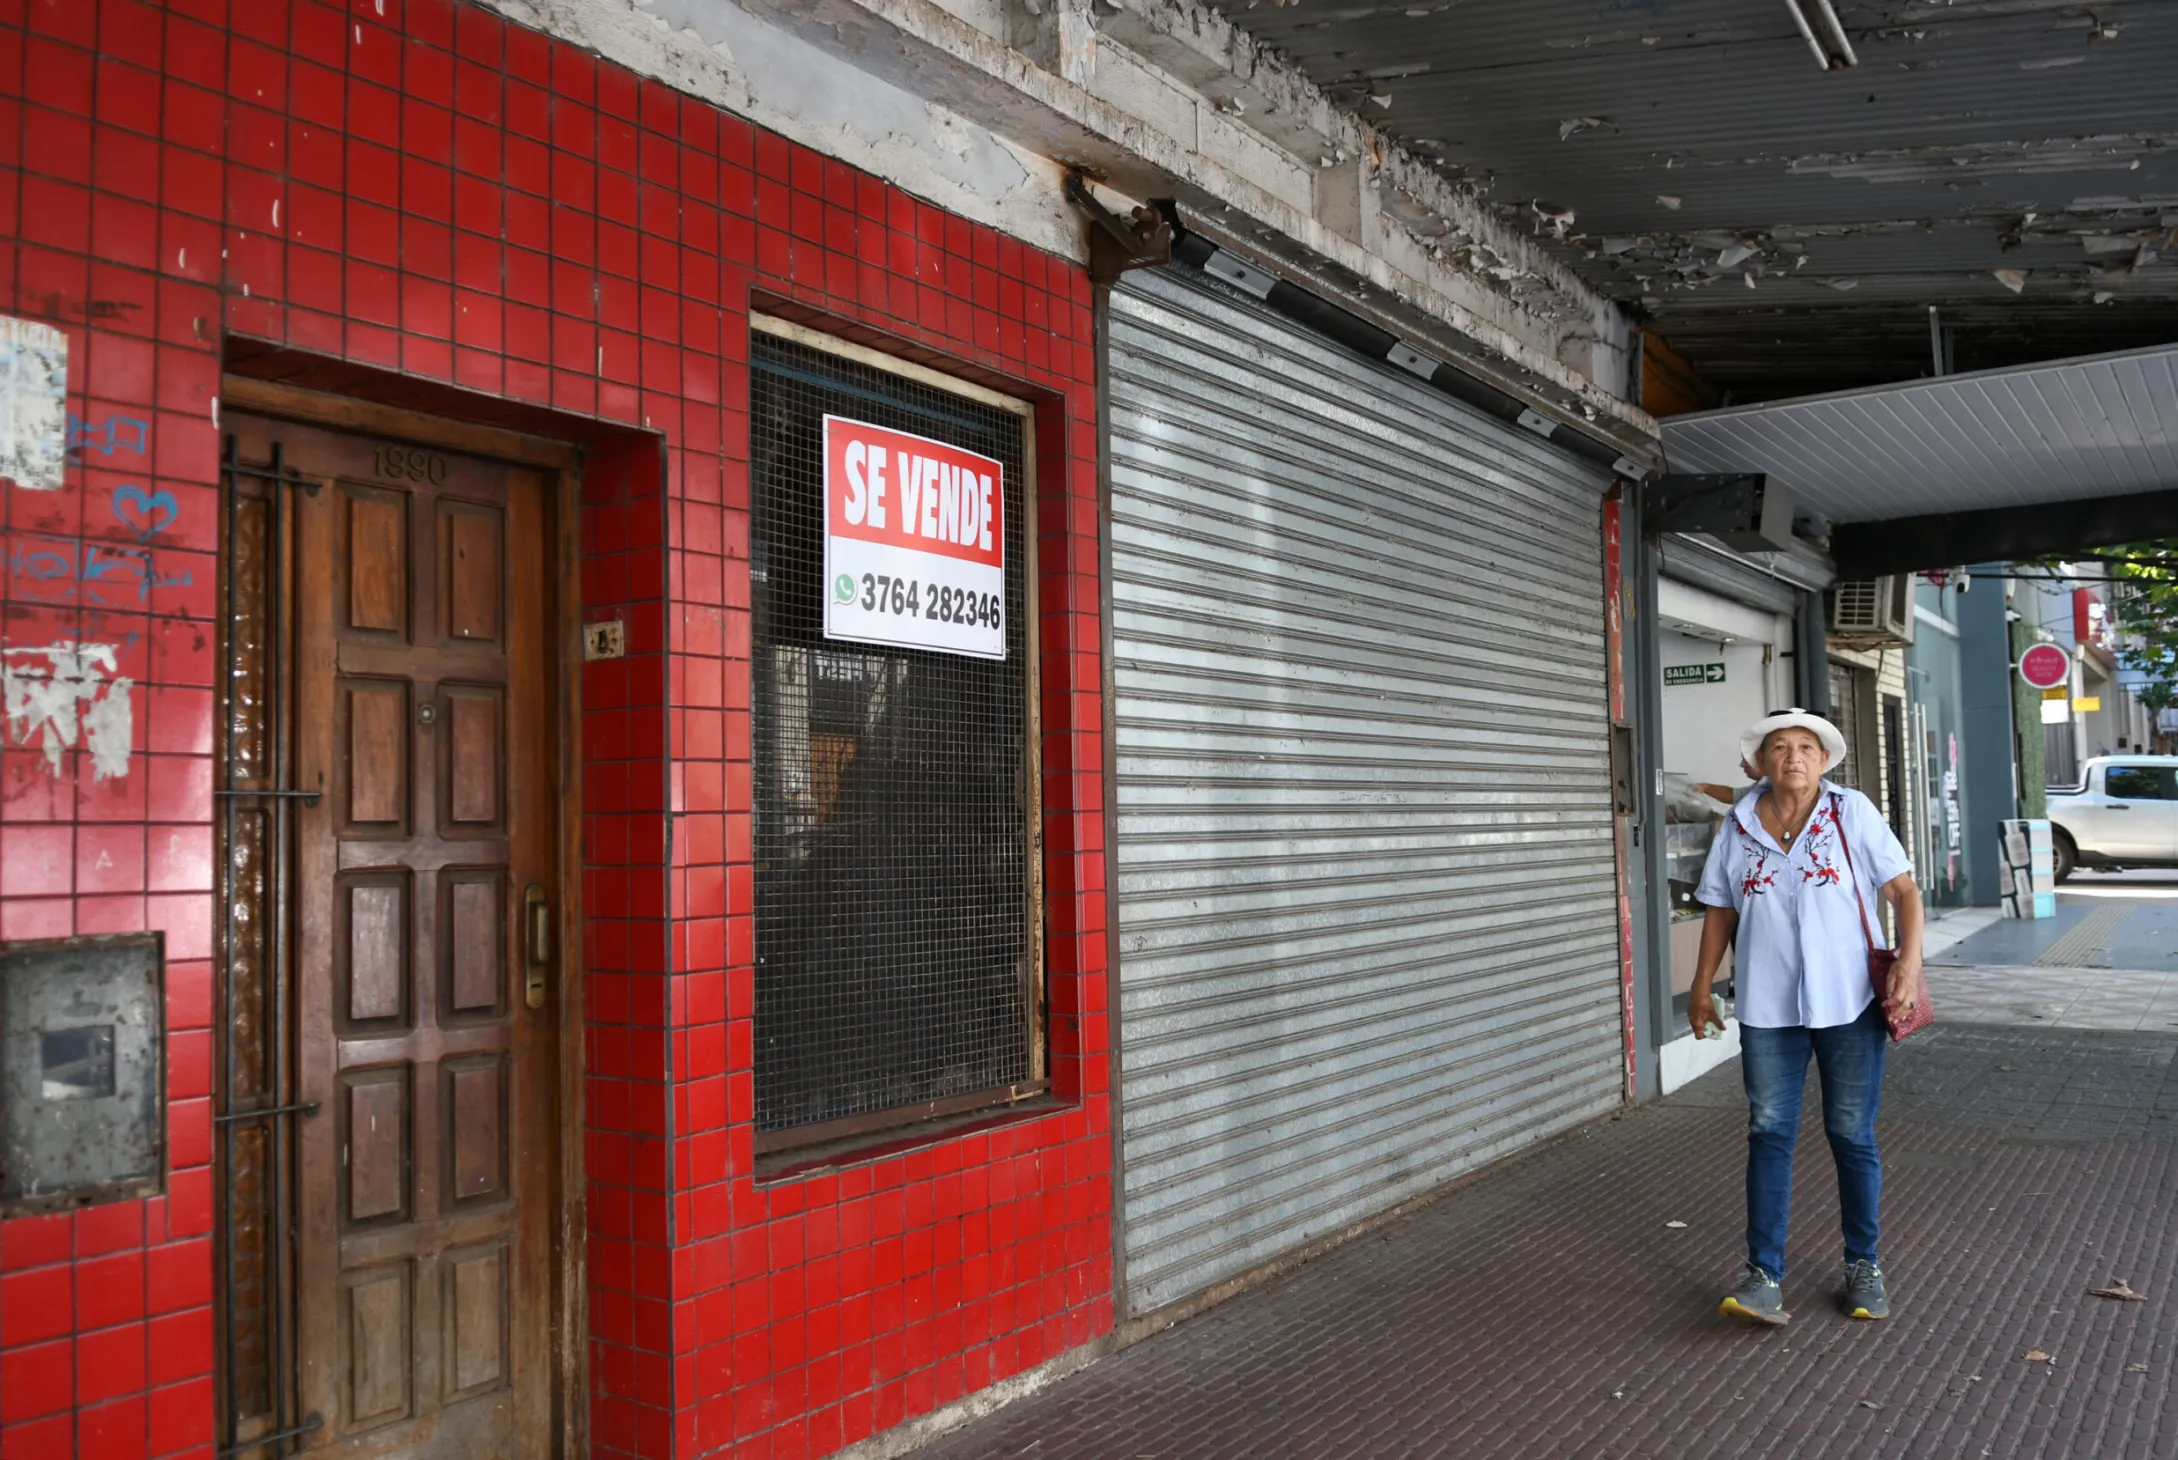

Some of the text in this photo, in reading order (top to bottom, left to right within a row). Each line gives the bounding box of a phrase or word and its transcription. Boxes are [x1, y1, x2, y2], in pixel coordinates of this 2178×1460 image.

[374, 445, 446, 486] 1990
[844, 440, 992, 551] SE VENDE
[861, 573, 1001, 630] 3764 282346
[1666, 667, 1702, 678] SALIDA
